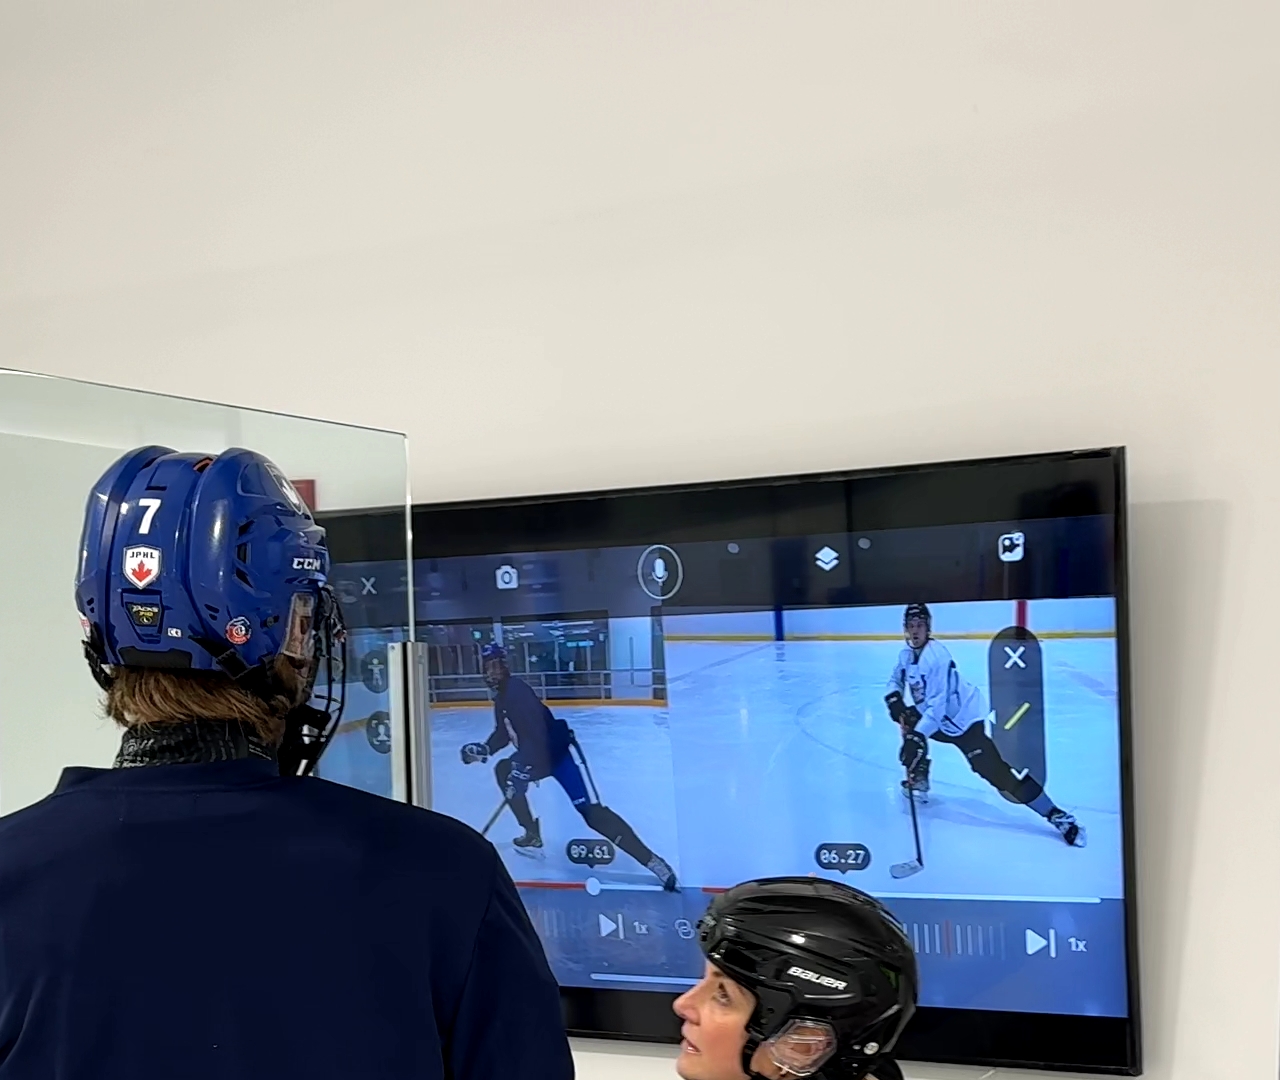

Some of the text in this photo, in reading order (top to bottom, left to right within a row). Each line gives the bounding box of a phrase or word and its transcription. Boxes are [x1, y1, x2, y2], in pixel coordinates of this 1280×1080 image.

[138, 498, 162, 535] 7
[129, 551, 156, 559] JPHL
[292, 557, 321, 570] CCM
[570, 845, 611, 859] 09.61
[819, 849, 866, 865] 06.27
[1068, 936, 1087, 952] 1x
[786, 966, 848, 991] BAUER
